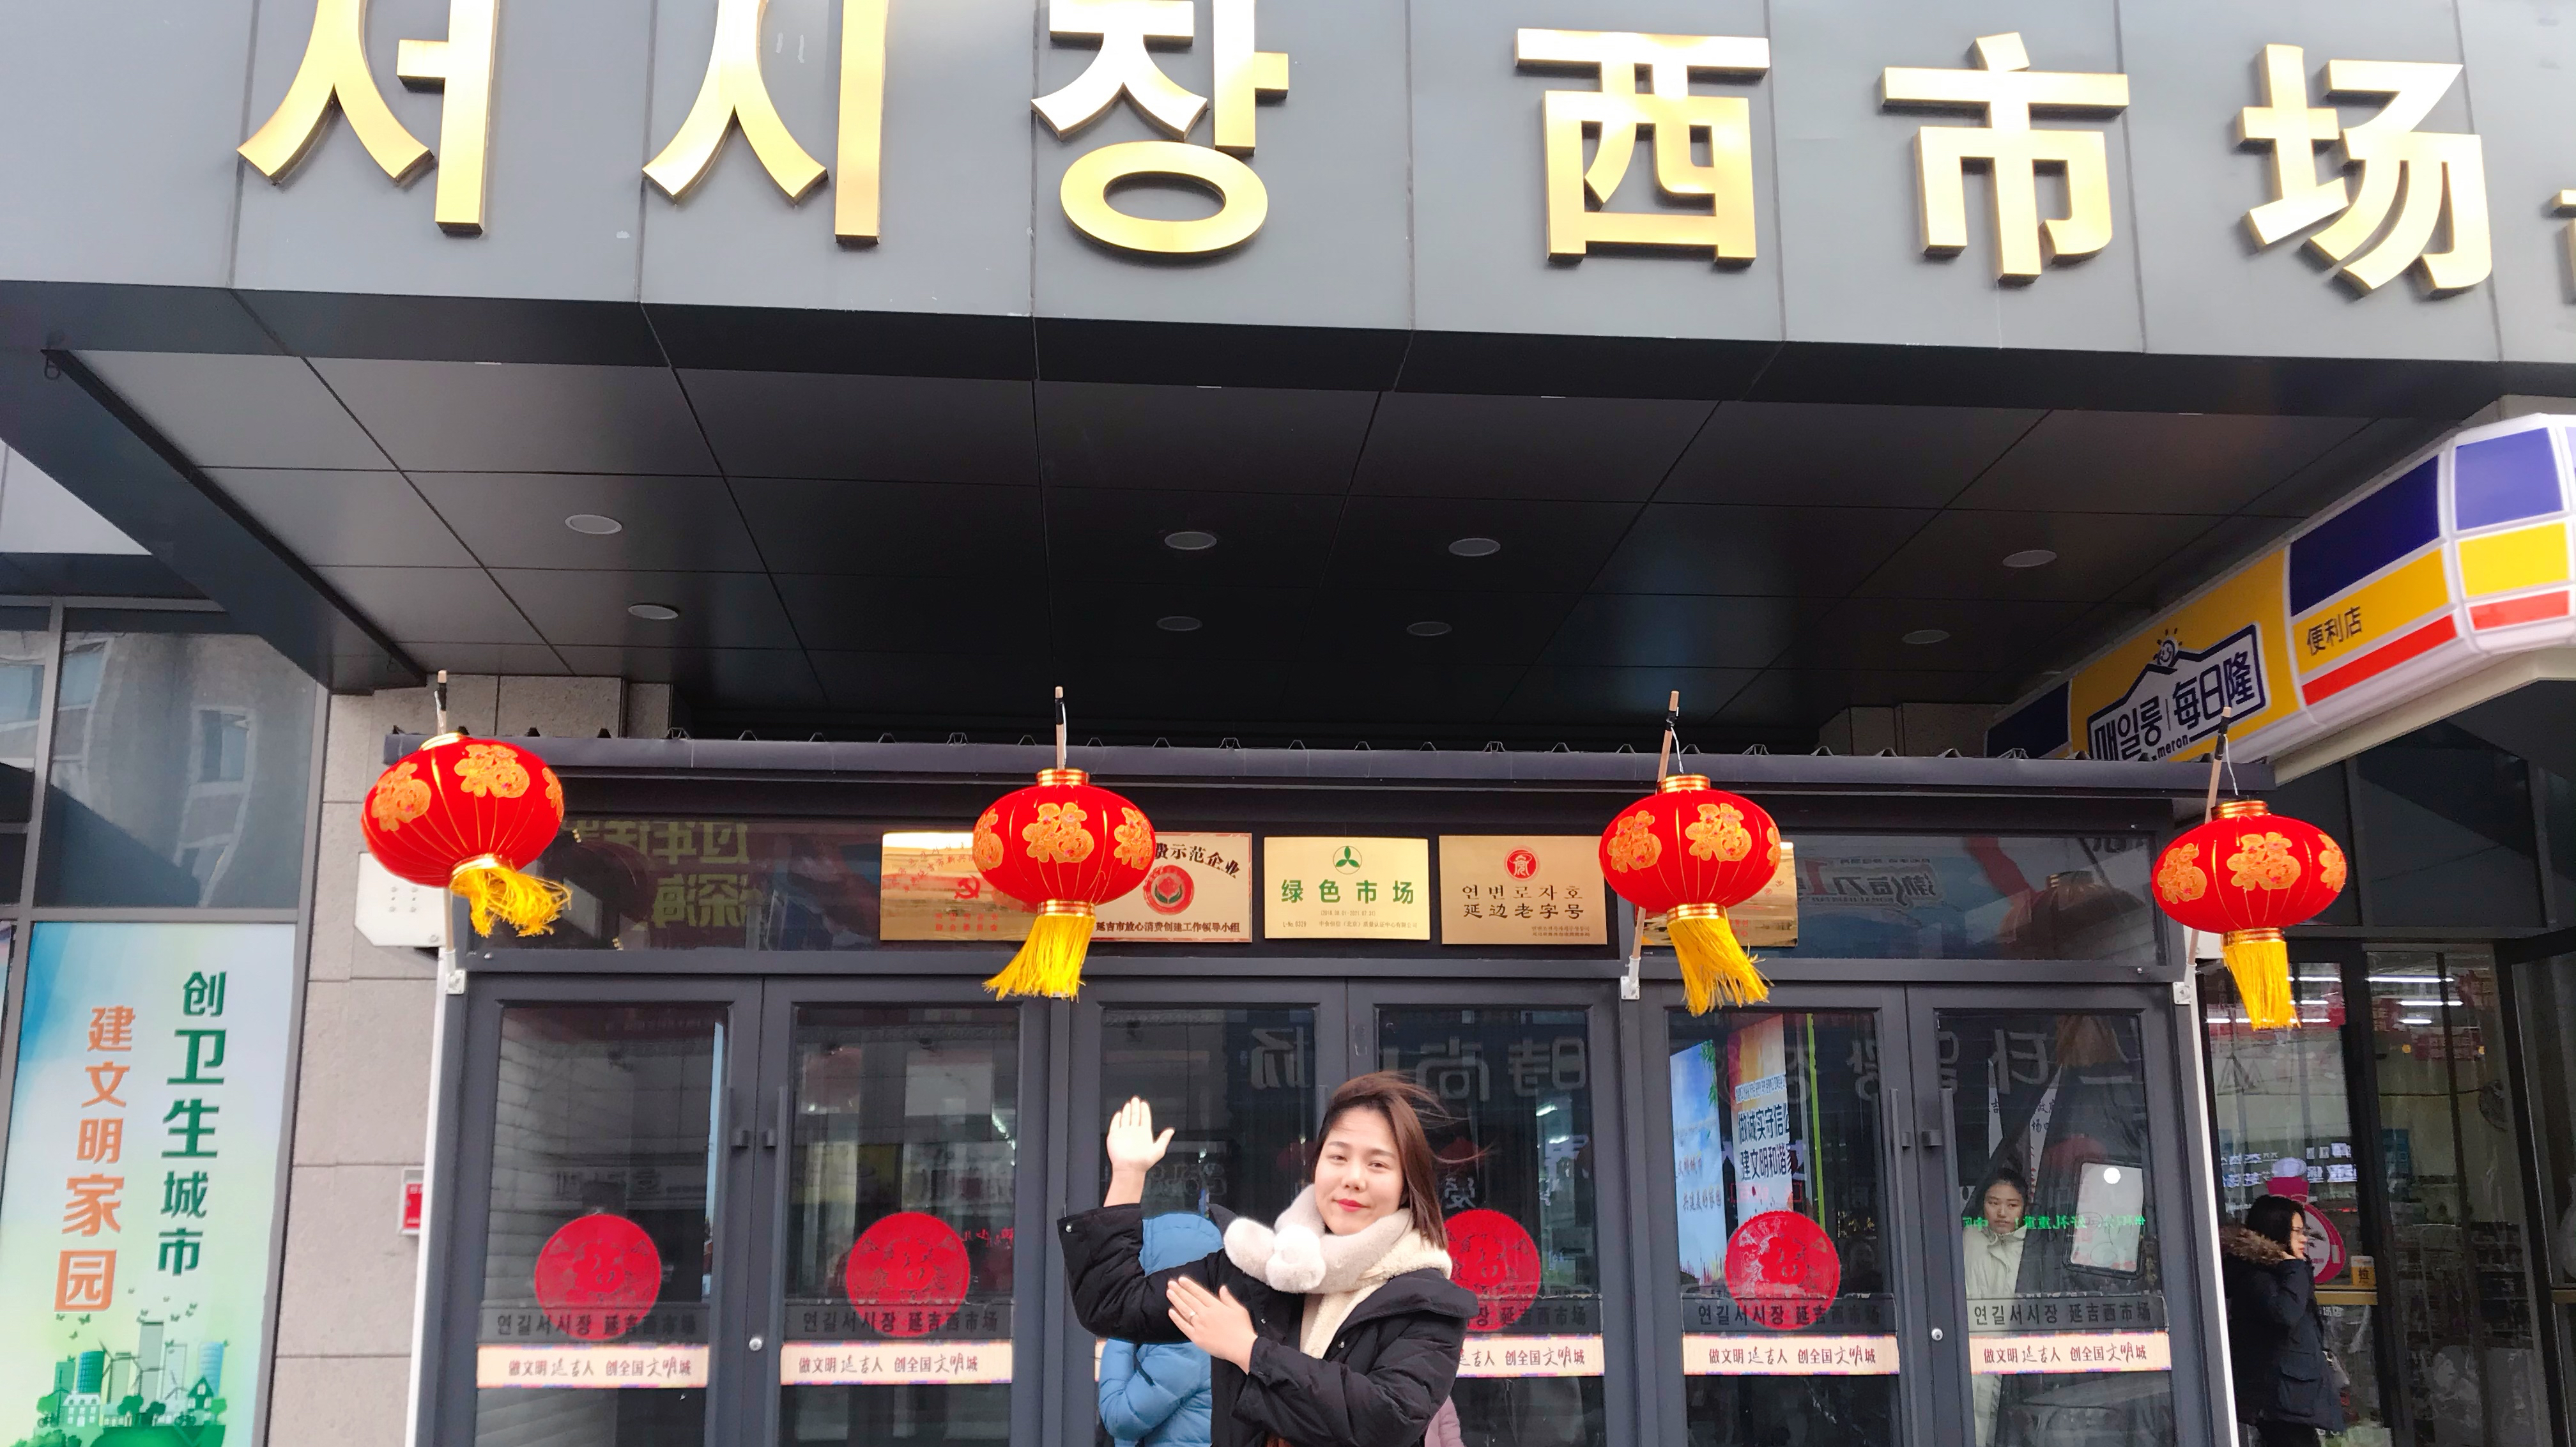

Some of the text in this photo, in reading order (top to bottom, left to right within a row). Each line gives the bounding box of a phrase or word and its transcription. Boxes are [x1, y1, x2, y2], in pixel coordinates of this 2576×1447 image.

[236, 0, 1289, 256] 서시장
[1515, 27, 2494, 295] 西市场
[2306, 606, 2363, 656] 便利店
[2172, 650, 2256, 730] 每日隆
[1280, 879, 1415, 905] 绿色市场
[1461, 884, 1584, 902] 연변로자호
[1462, 902, 1584, 919] 延边老字号
[1095, 921, 1241, 933] 延吉市放心消费创建工作领导小组
[157, 970, 227, 1277] 创卫生城市
[54, 1004, 137, 1313] 建文明家园
[803, 1311, 896, 1333] 연길서시장
[907, 1310, 998, 1333] 延吉西市场
[1698, 1305, 1784, 1326] 연길서시장
[1974, 1303, 2058, 1326] 연길서시장
[2069, 1301, 2151, 1323] 延吉西市场
[497, 1313, 592, 1336] 연길서시장
[798, 1352, 978, 1375] 做文明延吉人 创全国文明城
[1505, 1345, 1586, 1368] 创全国文明城
[1708, 1344, 1876, 1367] 做文明延吉人 创全国文明城
[1983, 1341, 2147, 1364] 做文明延吉人 创全国文明城
[508, 1356, 692, 1379] 做文明延吉人 创全国文明城
